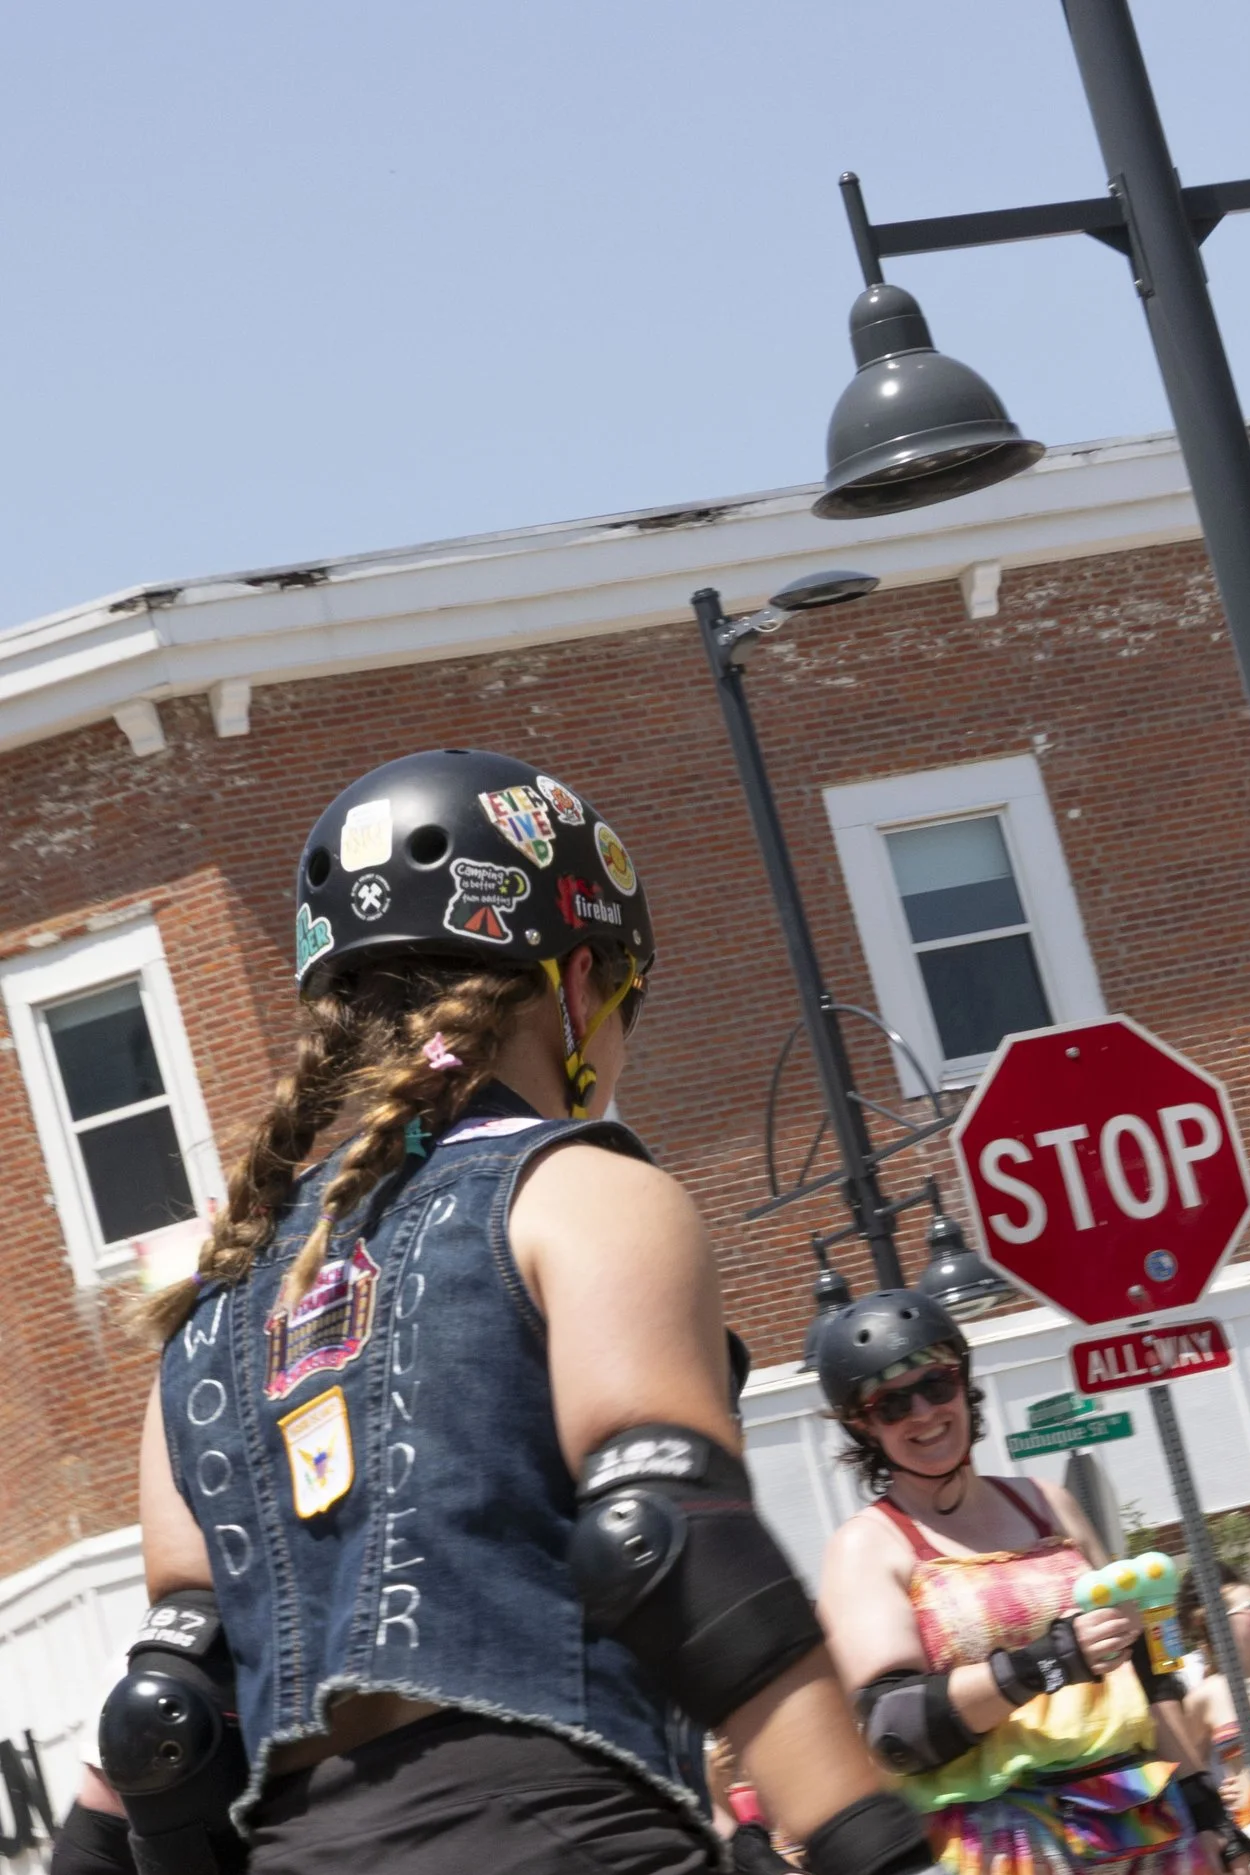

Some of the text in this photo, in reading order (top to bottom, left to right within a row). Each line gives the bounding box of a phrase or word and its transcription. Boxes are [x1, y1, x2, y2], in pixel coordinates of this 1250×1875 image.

[575, 894, 622, 925] fireball
[979, 1103, 1223, 1245] STOP
[1087, 1330, 1216, 1384] ALL WAY
